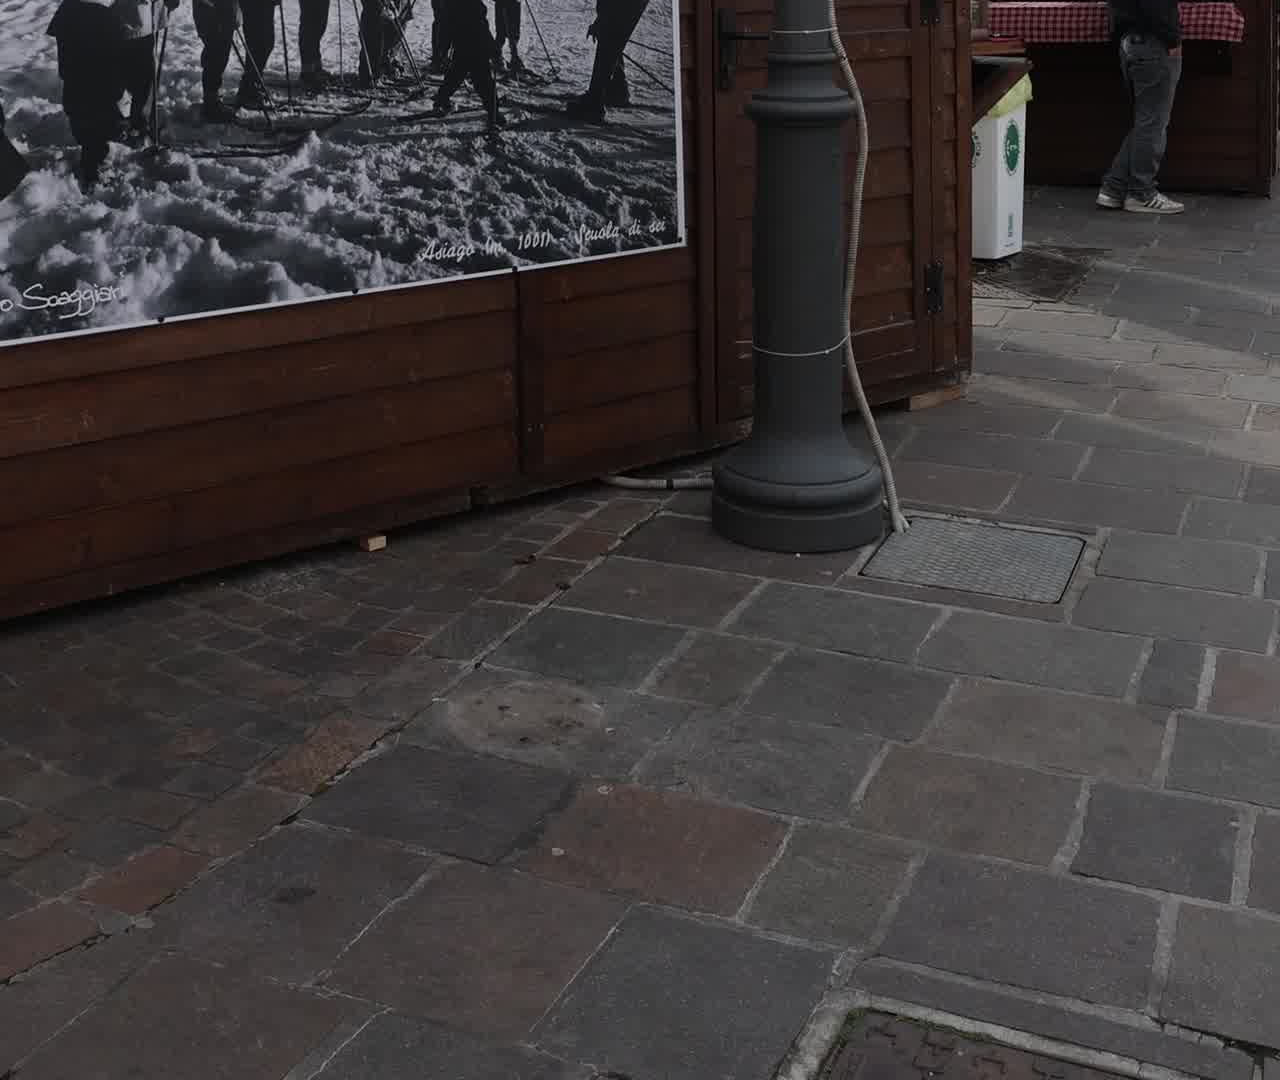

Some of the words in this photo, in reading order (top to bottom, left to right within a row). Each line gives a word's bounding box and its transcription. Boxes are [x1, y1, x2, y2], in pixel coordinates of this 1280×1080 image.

[420, 239, 475, 263] Asiago
[574, 220, 620, 242] Scuola
[629, 218, 641, 236] di
